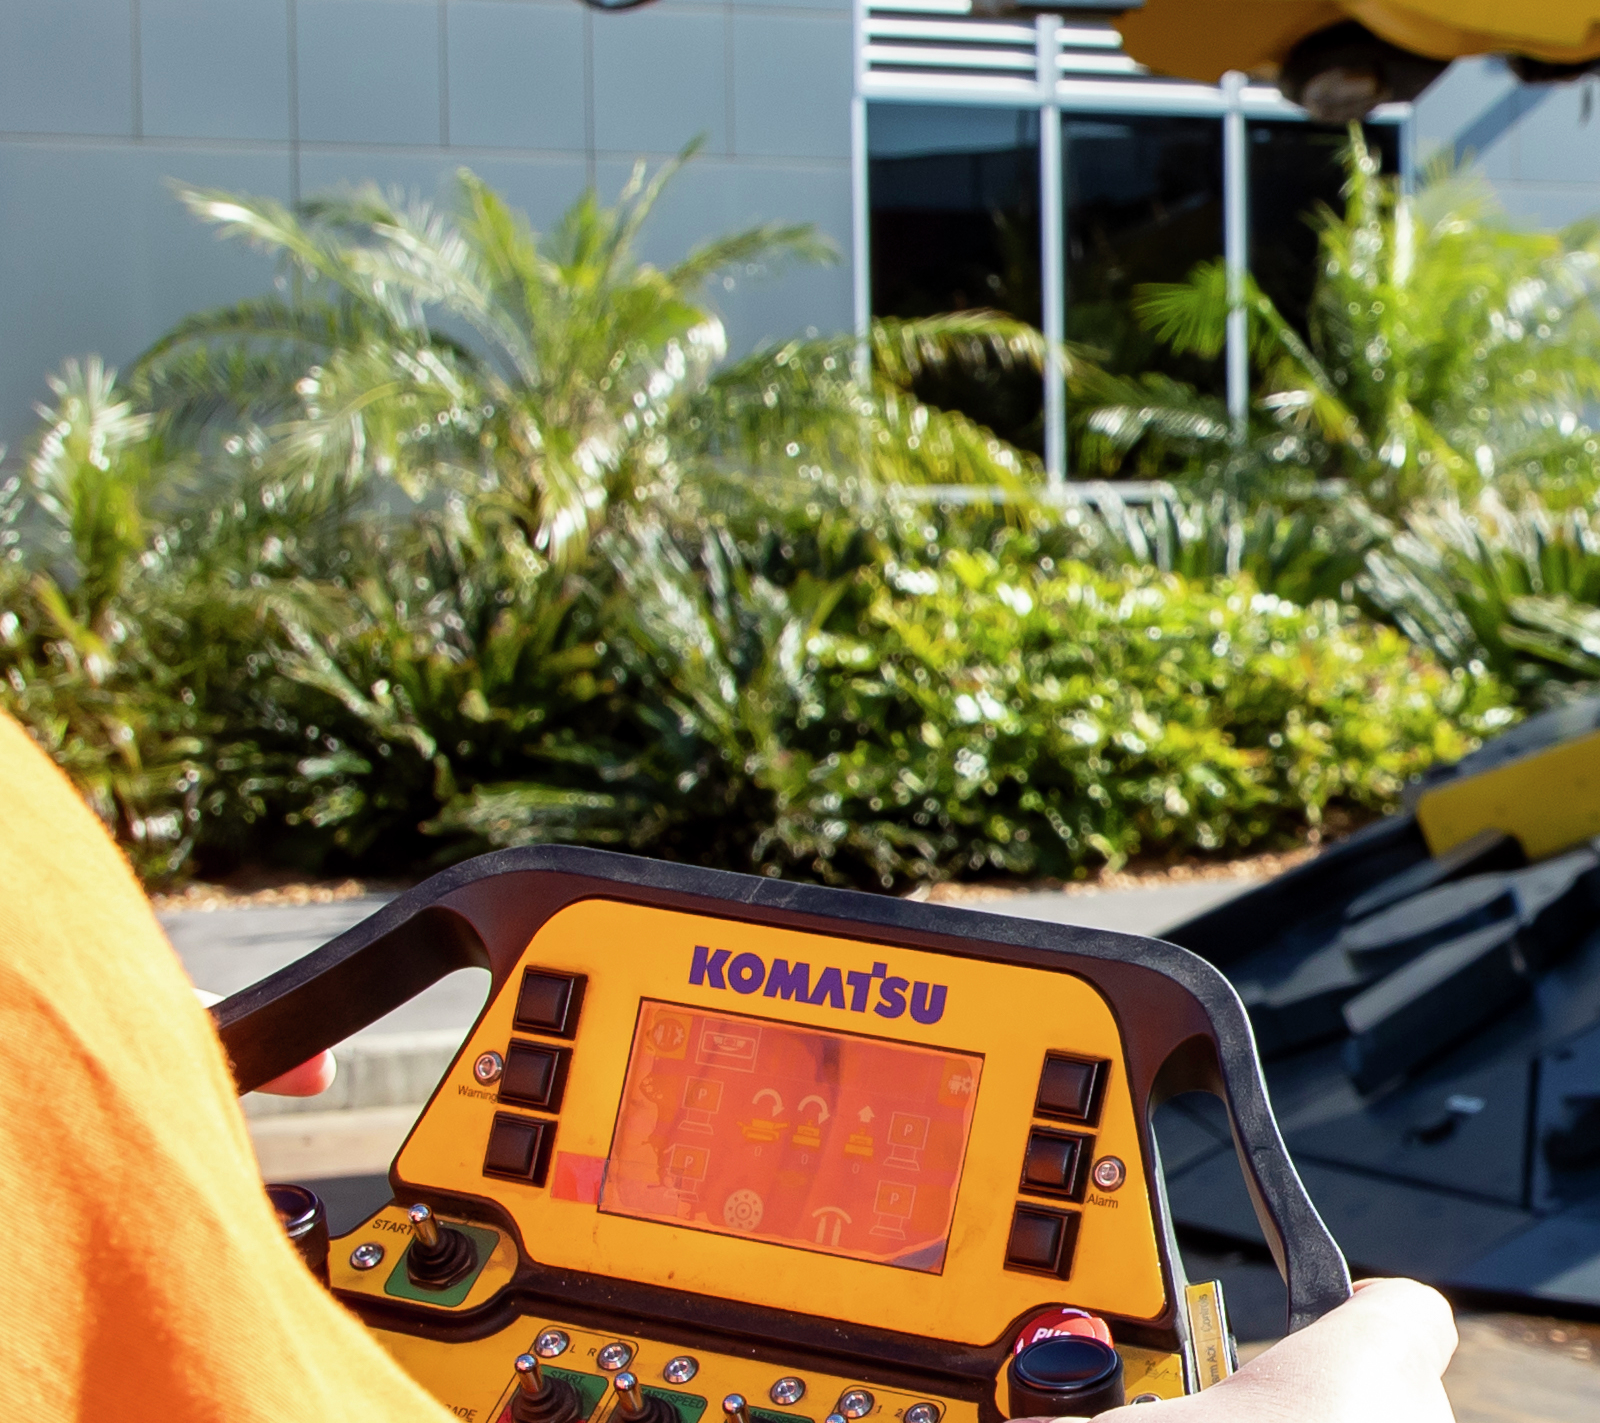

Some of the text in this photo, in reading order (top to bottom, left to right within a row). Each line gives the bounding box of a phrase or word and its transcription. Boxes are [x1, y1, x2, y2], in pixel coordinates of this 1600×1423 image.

[689, 945, 948, 1025] KOMATSU
[1086, 1193, 1119, 1209] Alarm
[372, 1219, 413, 1236] START
[569, 1344, 575, 1354] L
[587, 1347, 597, 1357] R
[875, 1405, 883, 1414] 1
[894, 1408, 904, 1418] 2
